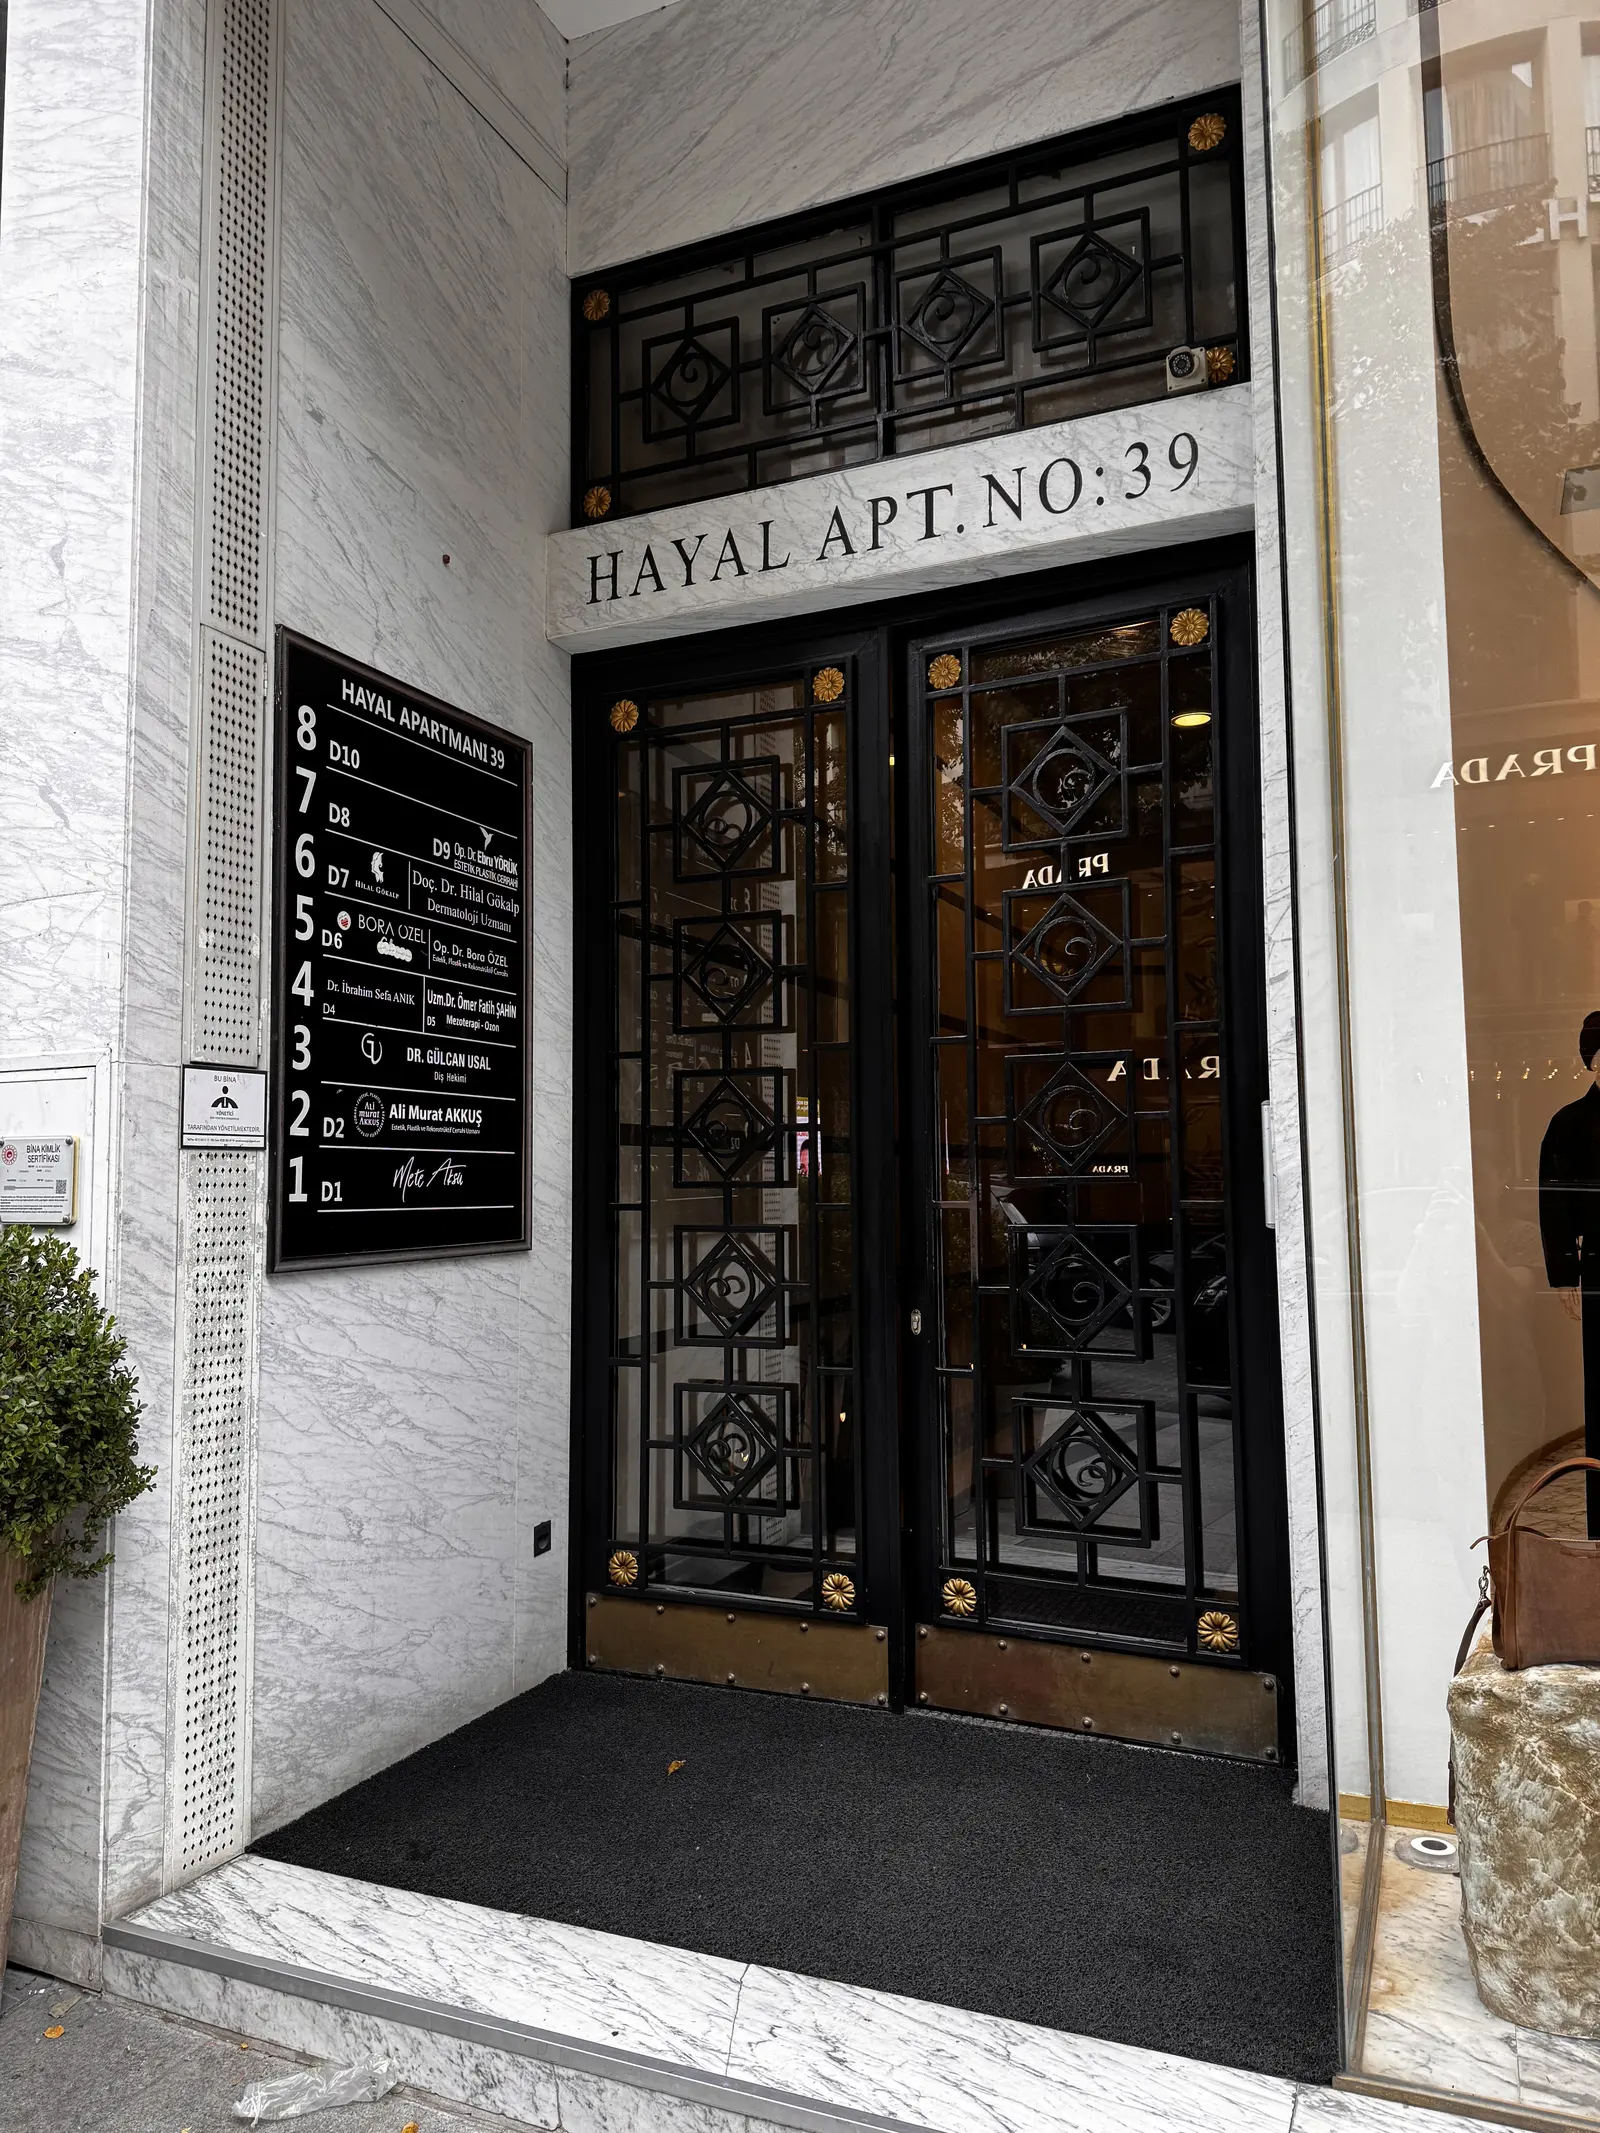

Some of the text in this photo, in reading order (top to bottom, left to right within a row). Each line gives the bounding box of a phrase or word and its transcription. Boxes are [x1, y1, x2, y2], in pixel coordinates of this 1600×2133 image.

[587, 520, 791, 605] HAYAL
[297, 705, 316, 750] 8
[342, 679, 504, 769] HAYAL APARTMANI 39
[330, 740, 360, 769] D10
[296, 766, 316, 813] 7
[329, 802, 350, 827] D8
[295, 833, 315, 878] 6
[433, 838, 450, 860] D9
[454, 843, 517, 875] Op. Dr. Ebru YÖRÜK
[328, 865, 349, 888] D7
[454, 859, 475, 874] ESTETİK
[413, 870, 519, 917] Doç. Dr. Hilal Gökalp
[295, 894, 314, 941] 5
[359, 914, 394, 936] BORA
[428, 898, 511, 933] Dermatoloji Uzmanı
[322, 929, 342, 949] D6
[434, 940, 508, 968] Op. Dr. Bora ÖZEL
[292, 960, 314, 1006] 4
[327, 980, 415, 1006] Dr. İbrahim Sefa ANIK
[323, 1003, 335, 1015] D4
[458, 992, 476, 1012] Ömer
[478, 998, 494, 1015] Fatih
[496, 1002, 516, 1019] ŞAHİN
[427, 1016, 435, 1027] D5
[446, 1015, 480, 1031] Mezoterapi
[485, 1021, 499, 1032] Ozon
[292, 1025, 311, 1070] 3
[407, 1047, 491, 1070] DR. GÜLCAN USAL
[434, 1071, 467, 1083] Diş Hekimi
[289, 1090, 310, 1136] 2
[389, 1104, 482, 1127] Ali Murat AKKUŞ
[323, 1117, 344, 1138] D2
[27, 1143, 60, 1153] BİNA KİMLİK
[28, 1154, 59, 1163] SERTİFİKASI
[289, 1156, 308, 1202] 1
[322, 1182, 343, 1202] D1
